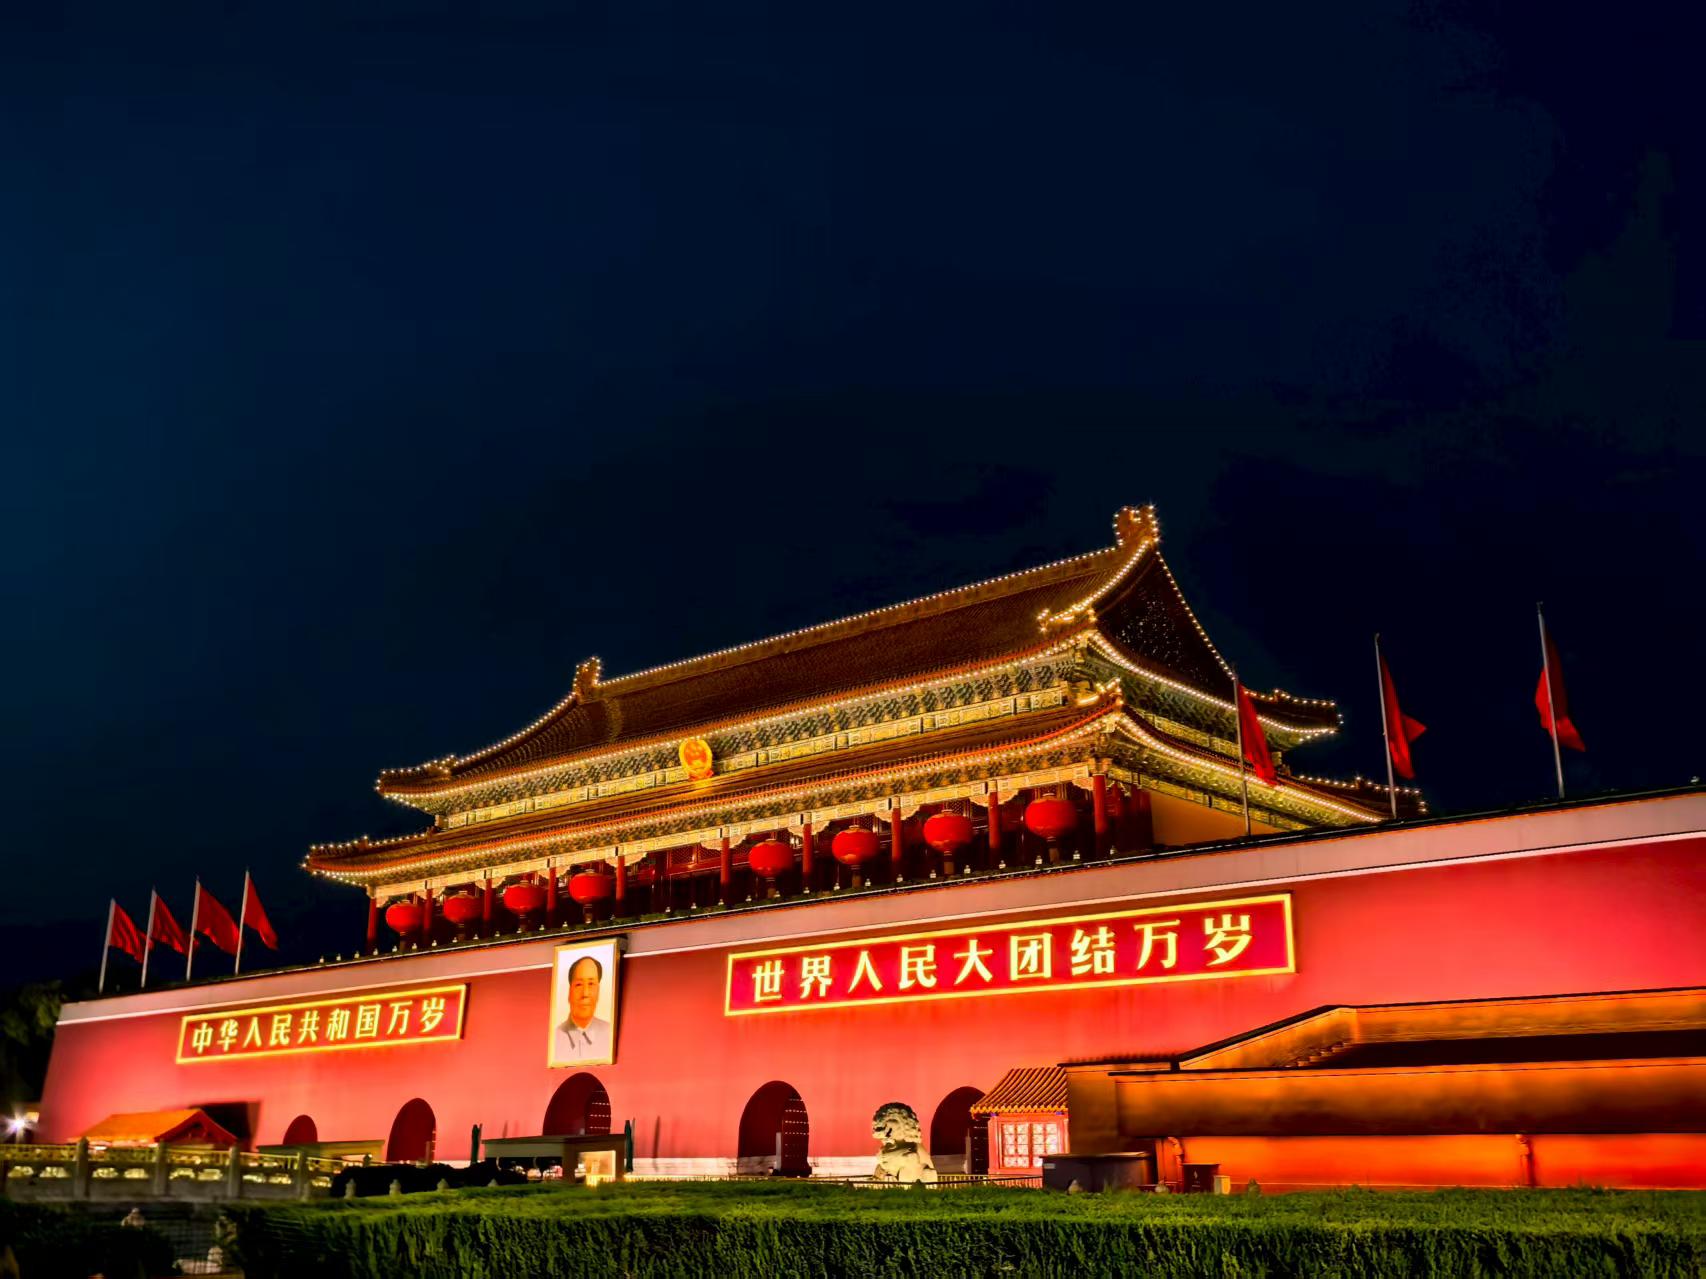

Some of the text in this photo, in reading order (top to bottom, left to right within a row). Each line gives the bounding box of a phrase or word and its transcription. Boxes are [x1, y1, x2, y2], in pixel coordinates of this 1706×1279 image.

[751, 913, 1255, 1003] 世界人民大团结万岁
[192, 997, 446, 1054] 中华人民共和国万岁
